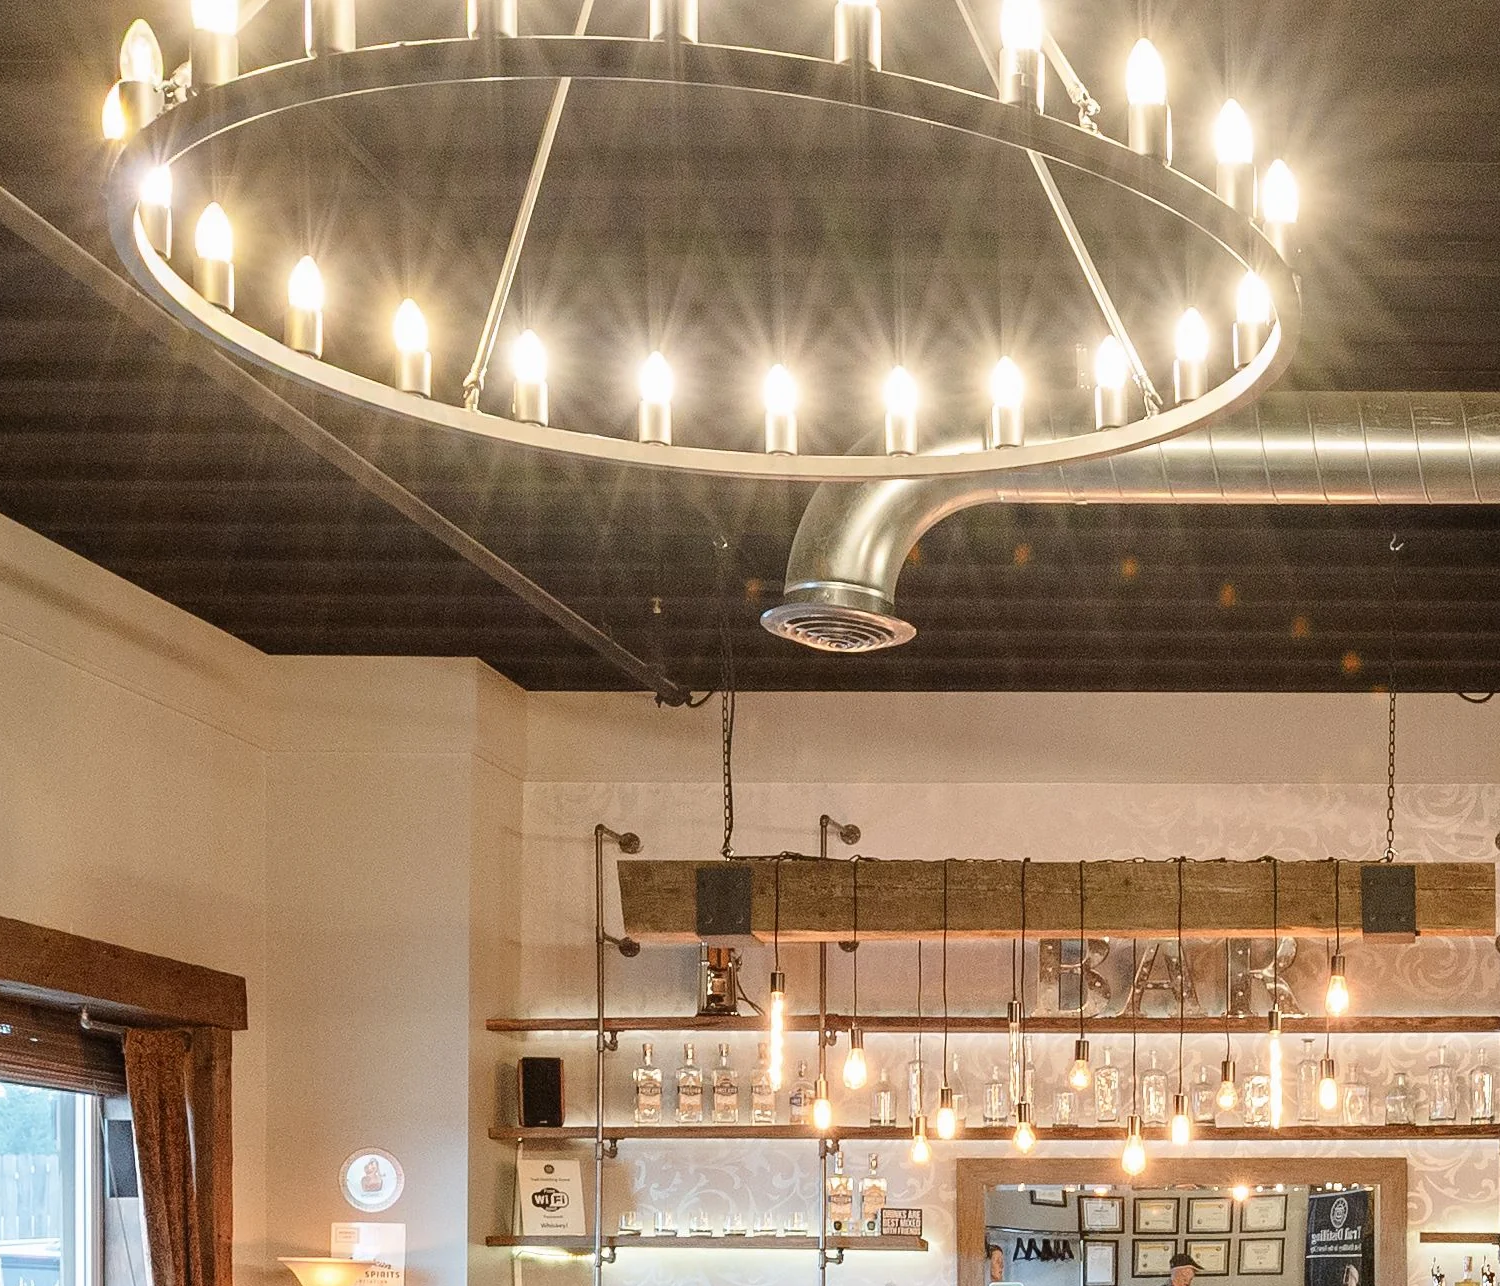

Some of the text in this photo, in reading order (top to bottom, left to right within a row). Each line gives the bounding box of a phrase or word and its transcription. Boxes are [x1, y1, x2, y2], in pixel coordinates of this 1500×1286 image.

[1031, 938, 1308, 1018] BAR
[908, 1210, 921, 1218] ARE
[883, 1219, 920, 1227] BEST MIXED
[365, 1271, 401, 1279] SPIRITS
